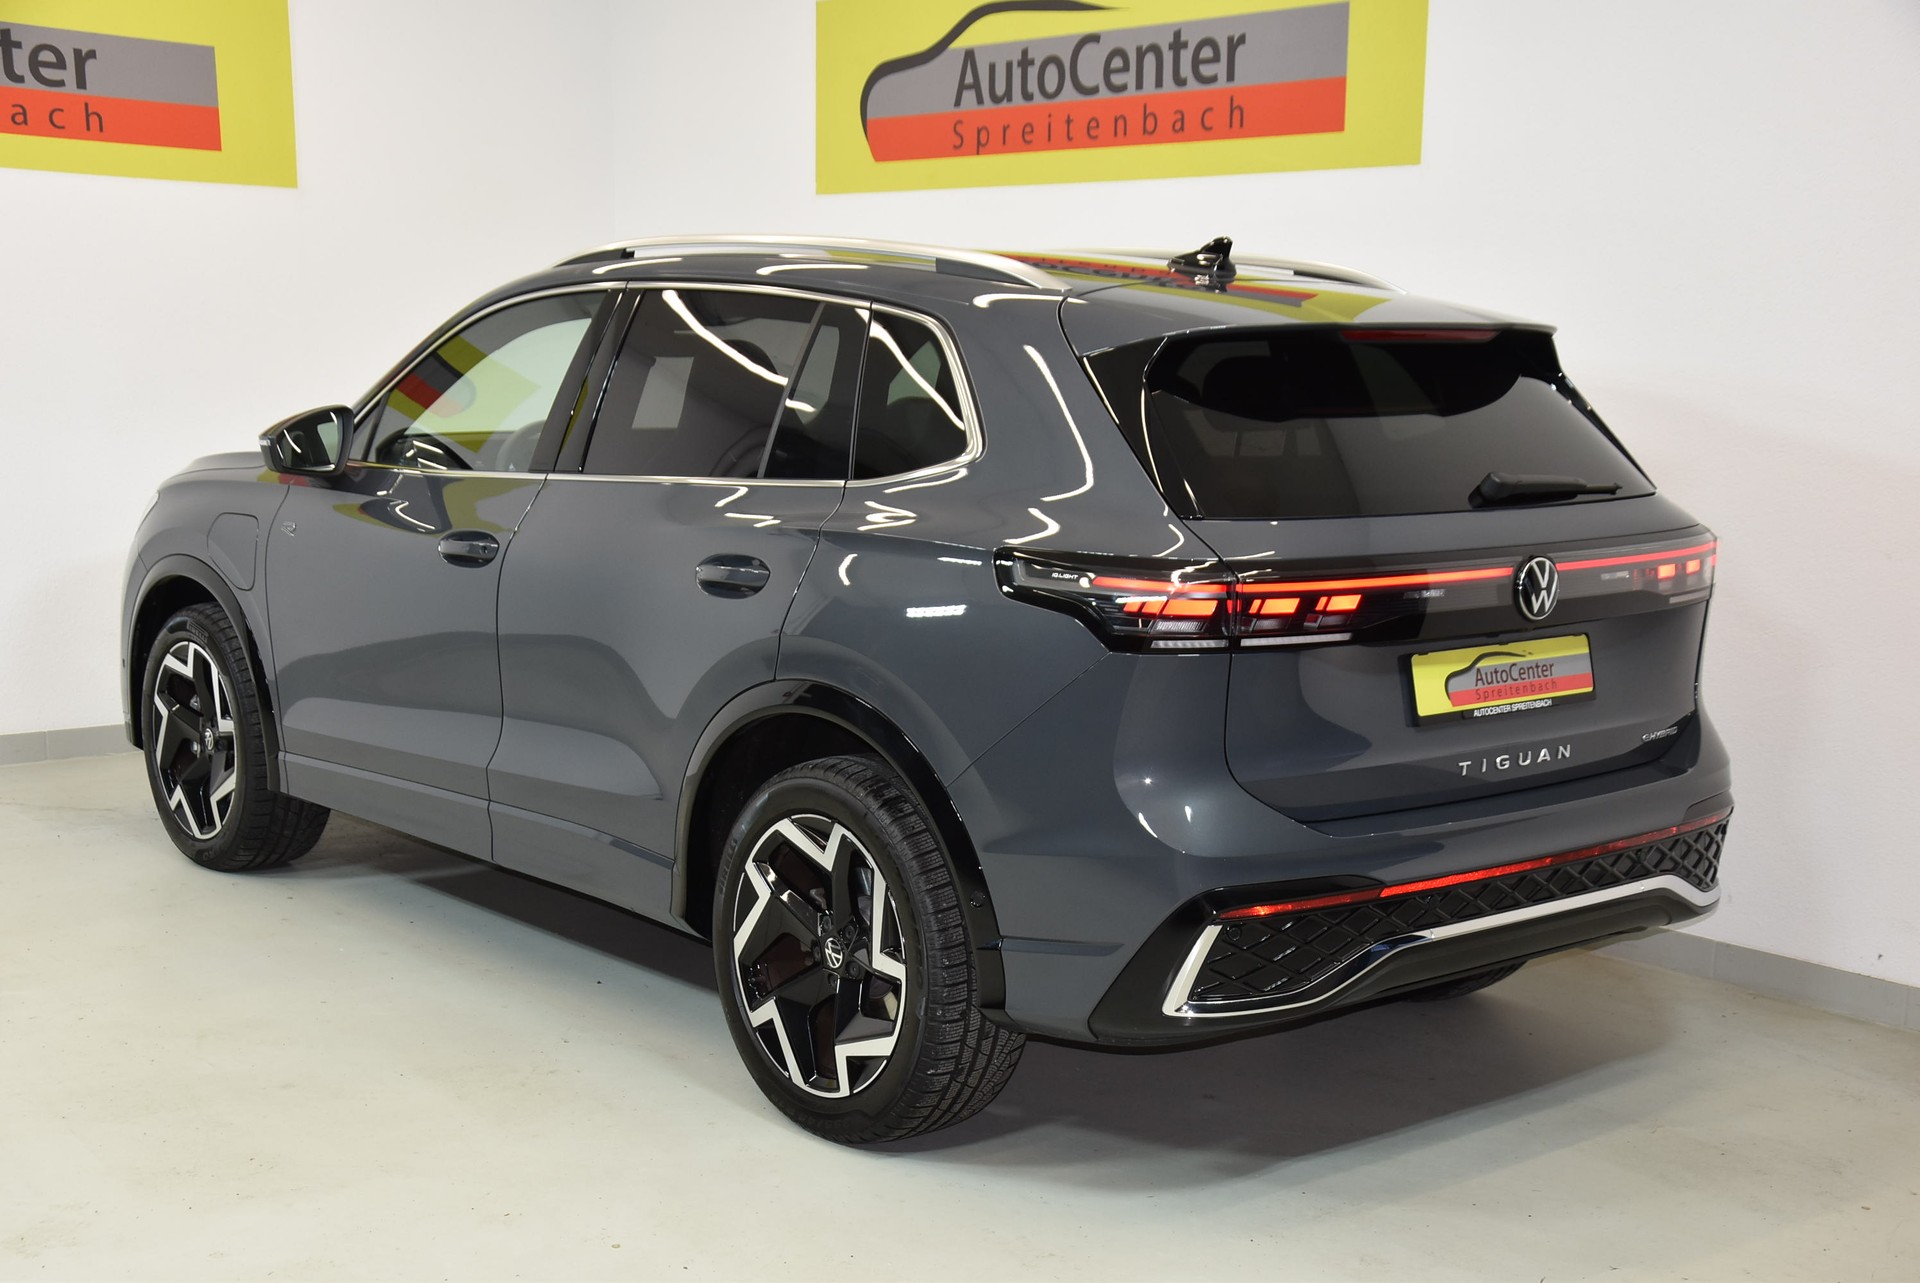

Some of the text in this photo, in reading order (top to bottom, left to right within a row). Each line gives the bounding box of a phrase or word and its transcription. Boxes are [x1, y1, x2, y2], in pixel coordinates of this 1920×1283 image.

[953, 28, 1247, 108] AutoCenter
[10, 102, 105, 133] ach
[952, 95, 1245, 156] Spreitenbach
[1475, 662, 1555, 687] AutoCenter
[1475, 678, 1558, 702] Spreitenbach
[1473, 698, 1553, 717] AUTOCENTER SPREITENBACH
[1458, 744, 1571, 776] TIGUAN
